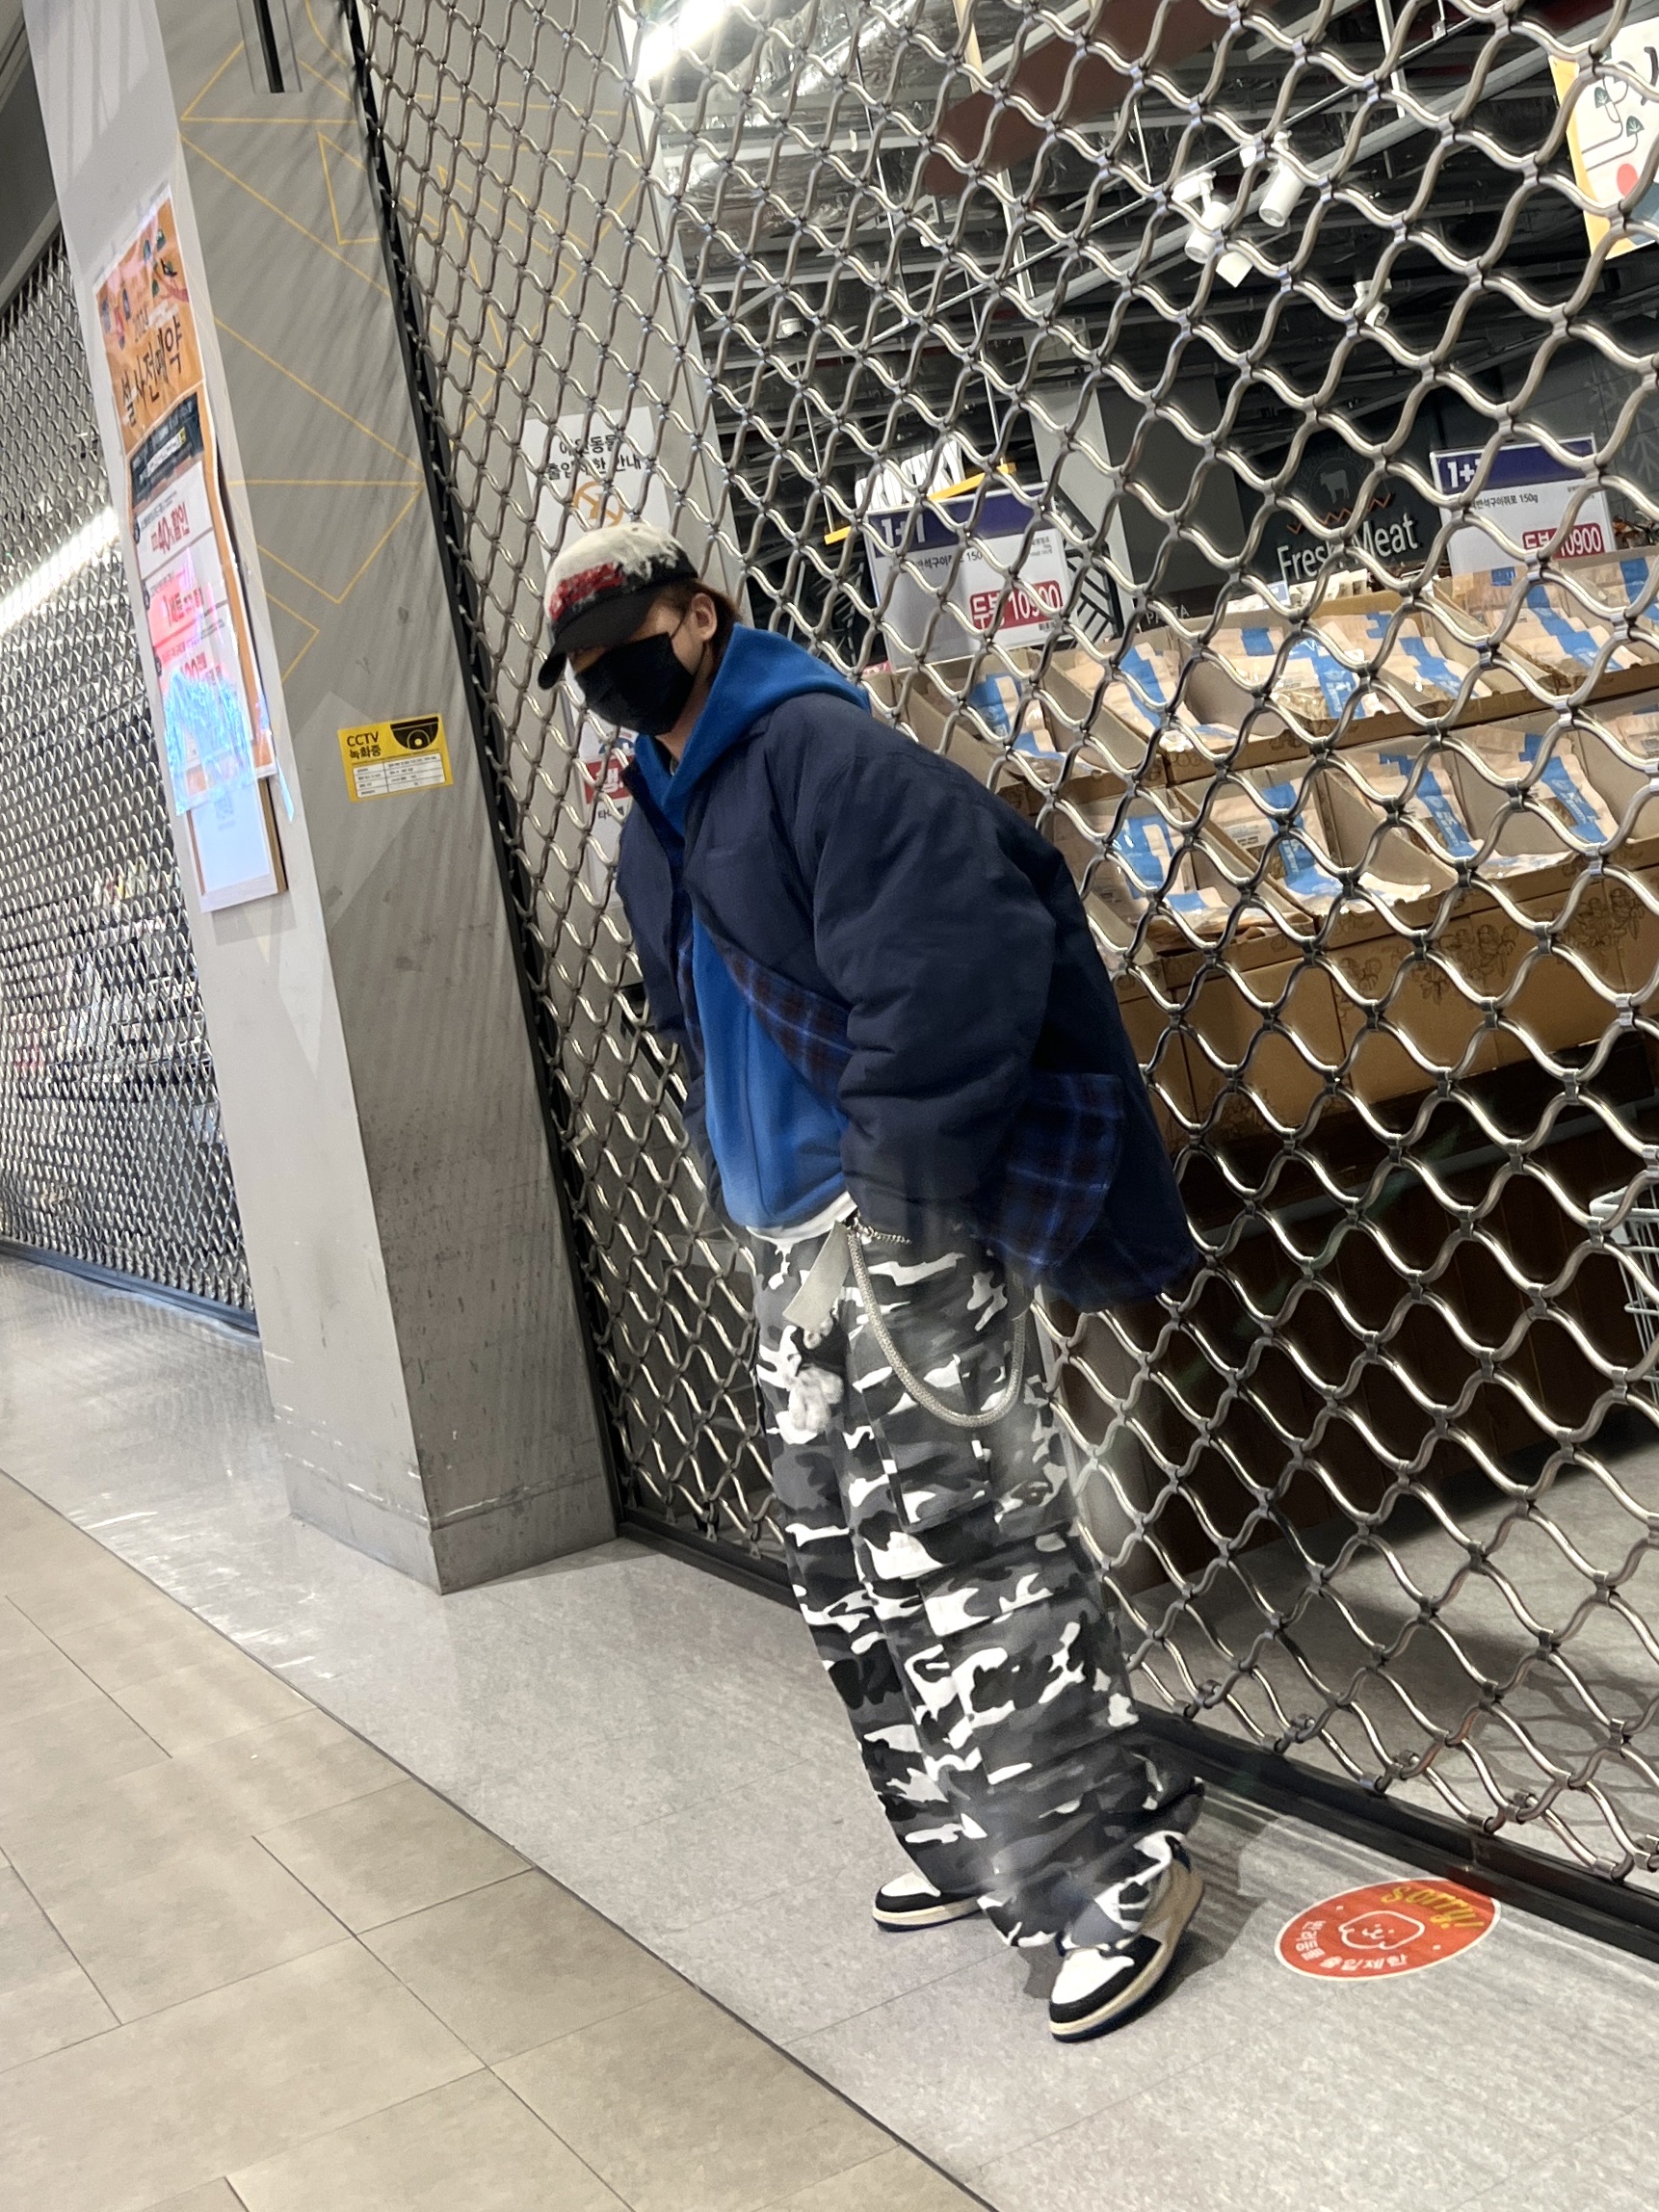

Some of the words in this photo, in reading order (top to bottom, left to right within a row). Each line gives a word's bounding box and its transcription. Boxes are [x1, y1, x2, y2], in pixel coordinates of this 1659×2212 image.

[1447, 458, 1481, 488] 1+
[1519, 492, 1539, 504] 150g
[1350, 512, 1419, 565] Meat
[1146, 604, 1190, 624] PTA
[347, 731, 379, 747] CCTV
